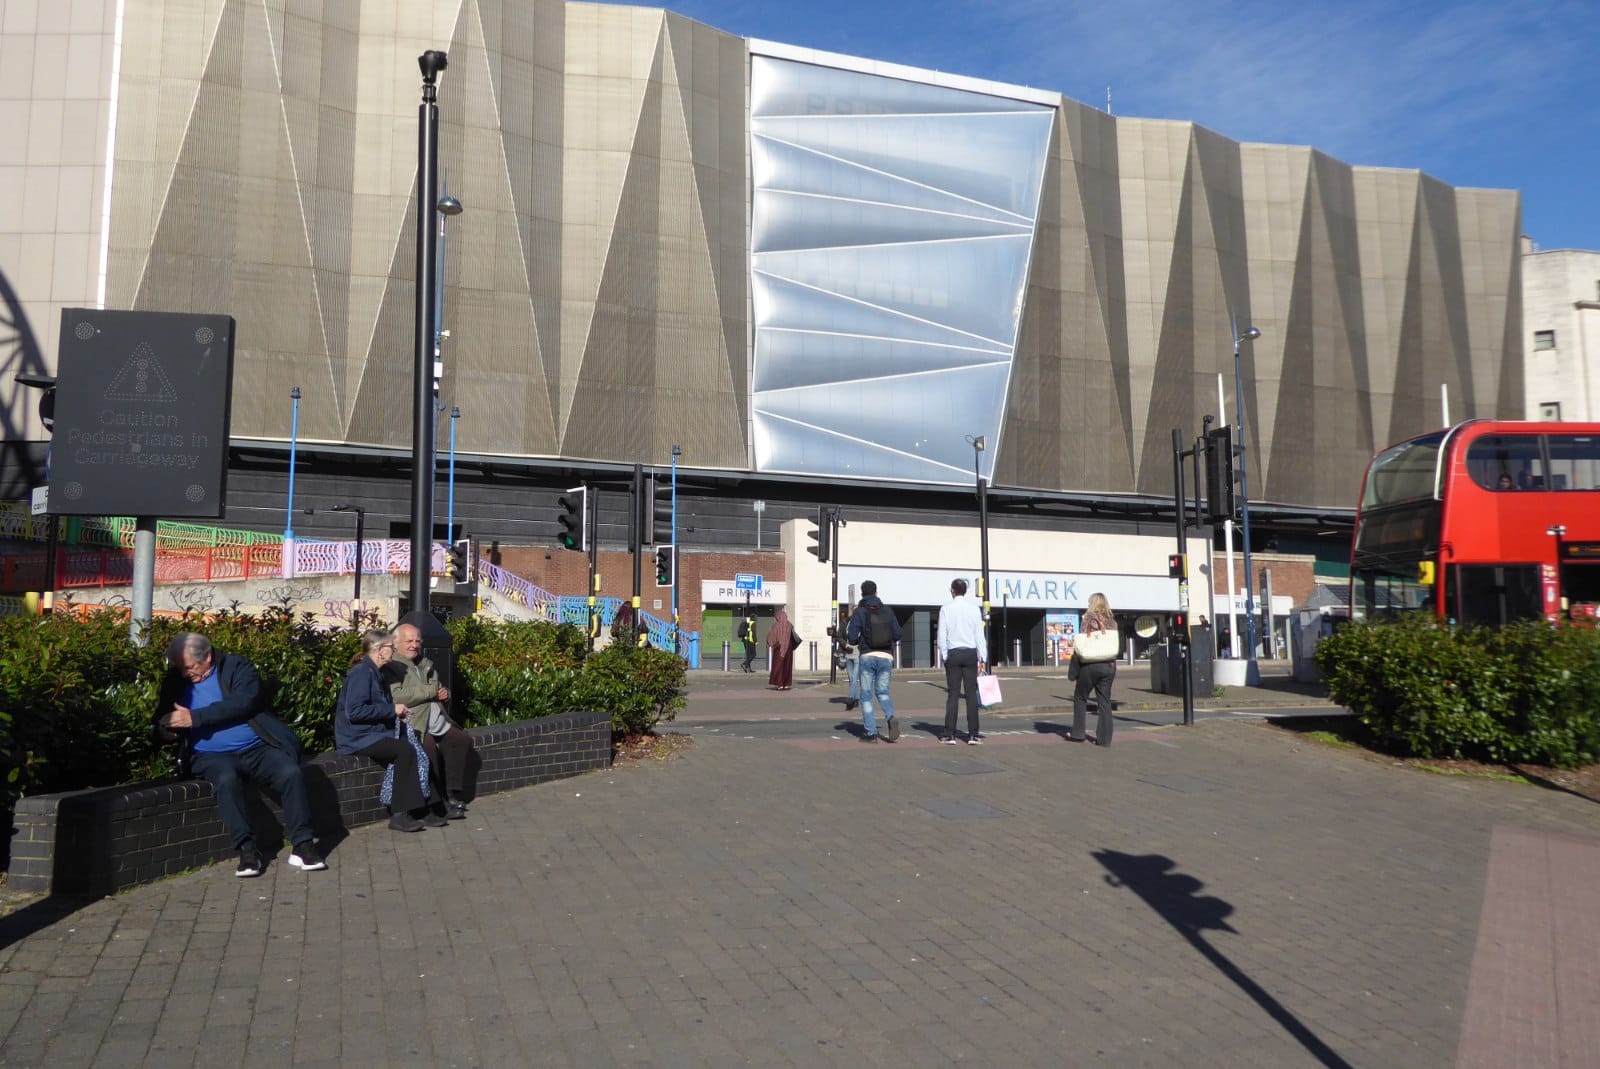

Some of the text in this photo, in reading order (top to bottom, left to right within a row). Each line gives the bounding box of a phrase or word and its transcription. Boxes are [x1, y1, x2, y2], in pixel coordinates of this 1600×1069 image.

[99, 408, 180, 428] Caution
[68, 427, 209, 448] Pedestrians in
[74, 448, 200, 470] Carriageway
[718, 587, 772, 598] PRIMARK
[960, 577, 1079, 600] IMARK
